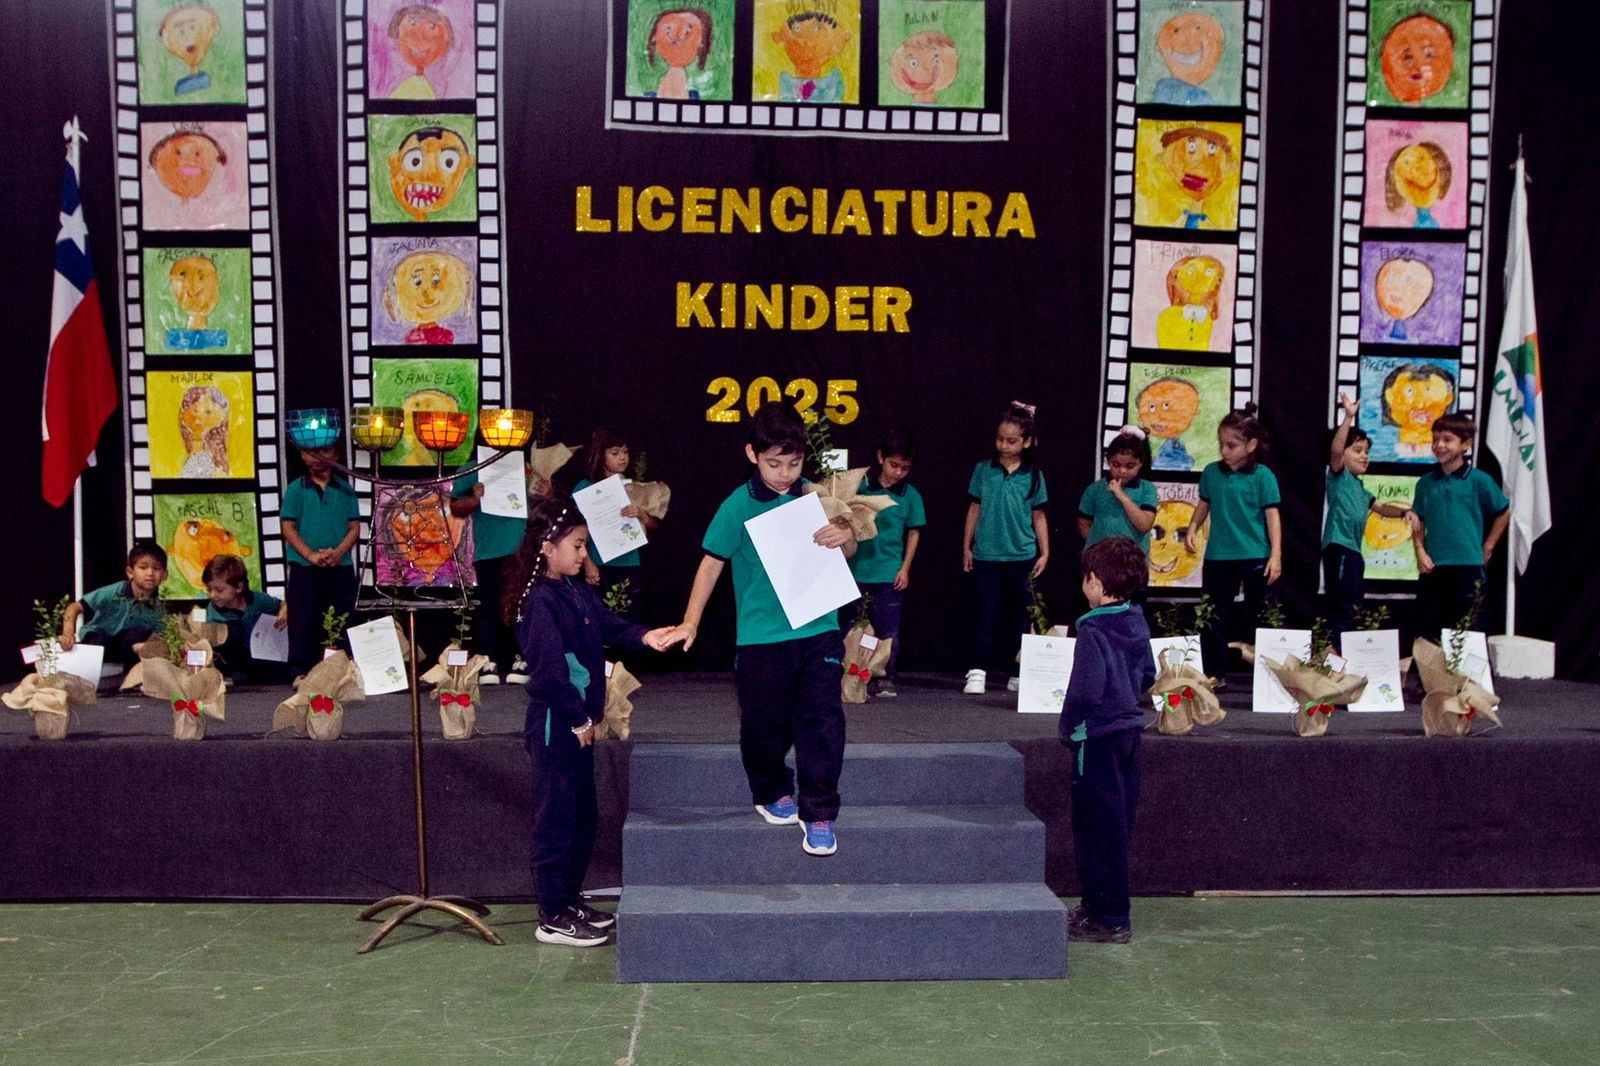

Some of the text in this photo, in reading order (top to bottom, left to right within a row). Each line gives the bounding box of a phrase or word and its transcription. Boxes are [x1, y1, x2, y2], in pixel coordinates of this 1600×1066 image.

[575, 185, 1037, 239] LICENCIATURA
[676, 281, 913, 333] KINDER
[394, 369, 454, 385] SAMUEL
[705, 376, 860, 425] 2025
[232, 501, 244, 522] B
